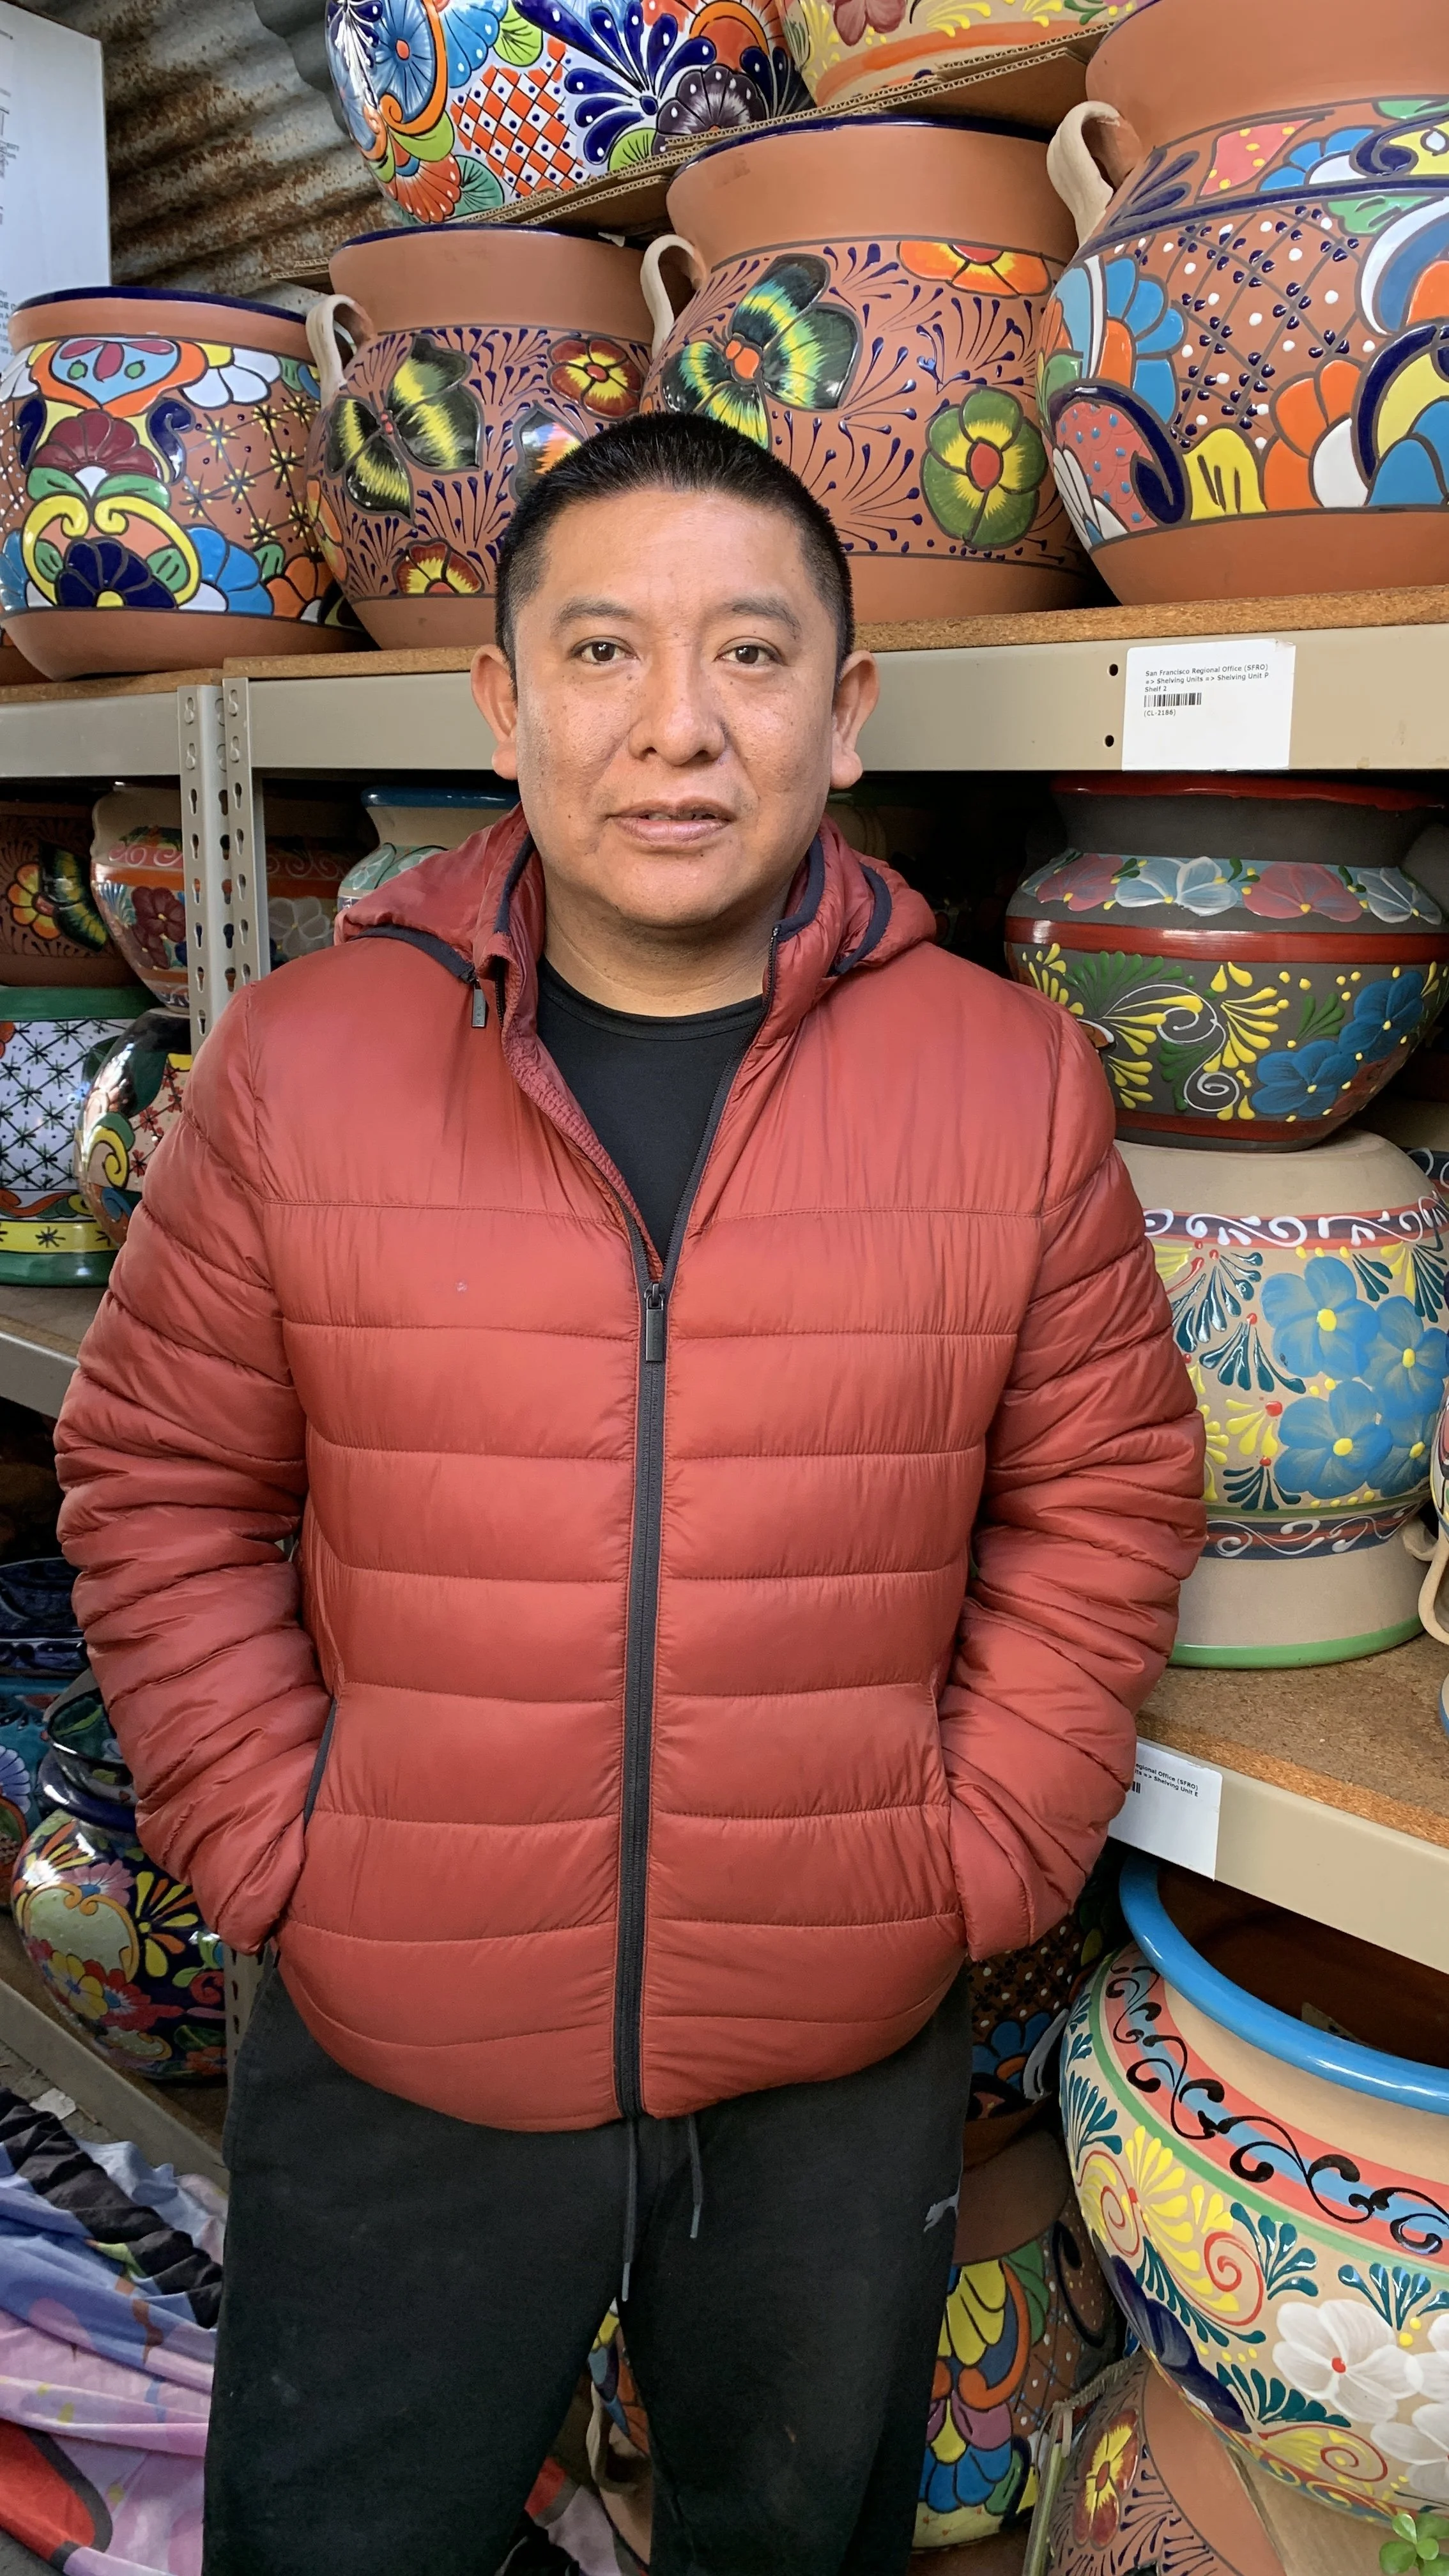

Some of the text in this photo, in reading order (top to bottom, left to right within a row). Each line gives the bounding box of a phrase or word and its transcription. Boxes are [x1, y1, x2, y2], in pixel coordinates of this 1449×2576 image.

[1192, 666, 1220, 675] Regional
[1245, 664, 1268, 672] (SFRO)
[1136, 1763, 1198, 1791] egional Office (SFRO)
[1154, 1776, 1179, 1791] Shelving
[1180, 1786, 1193, 1795] Unit
